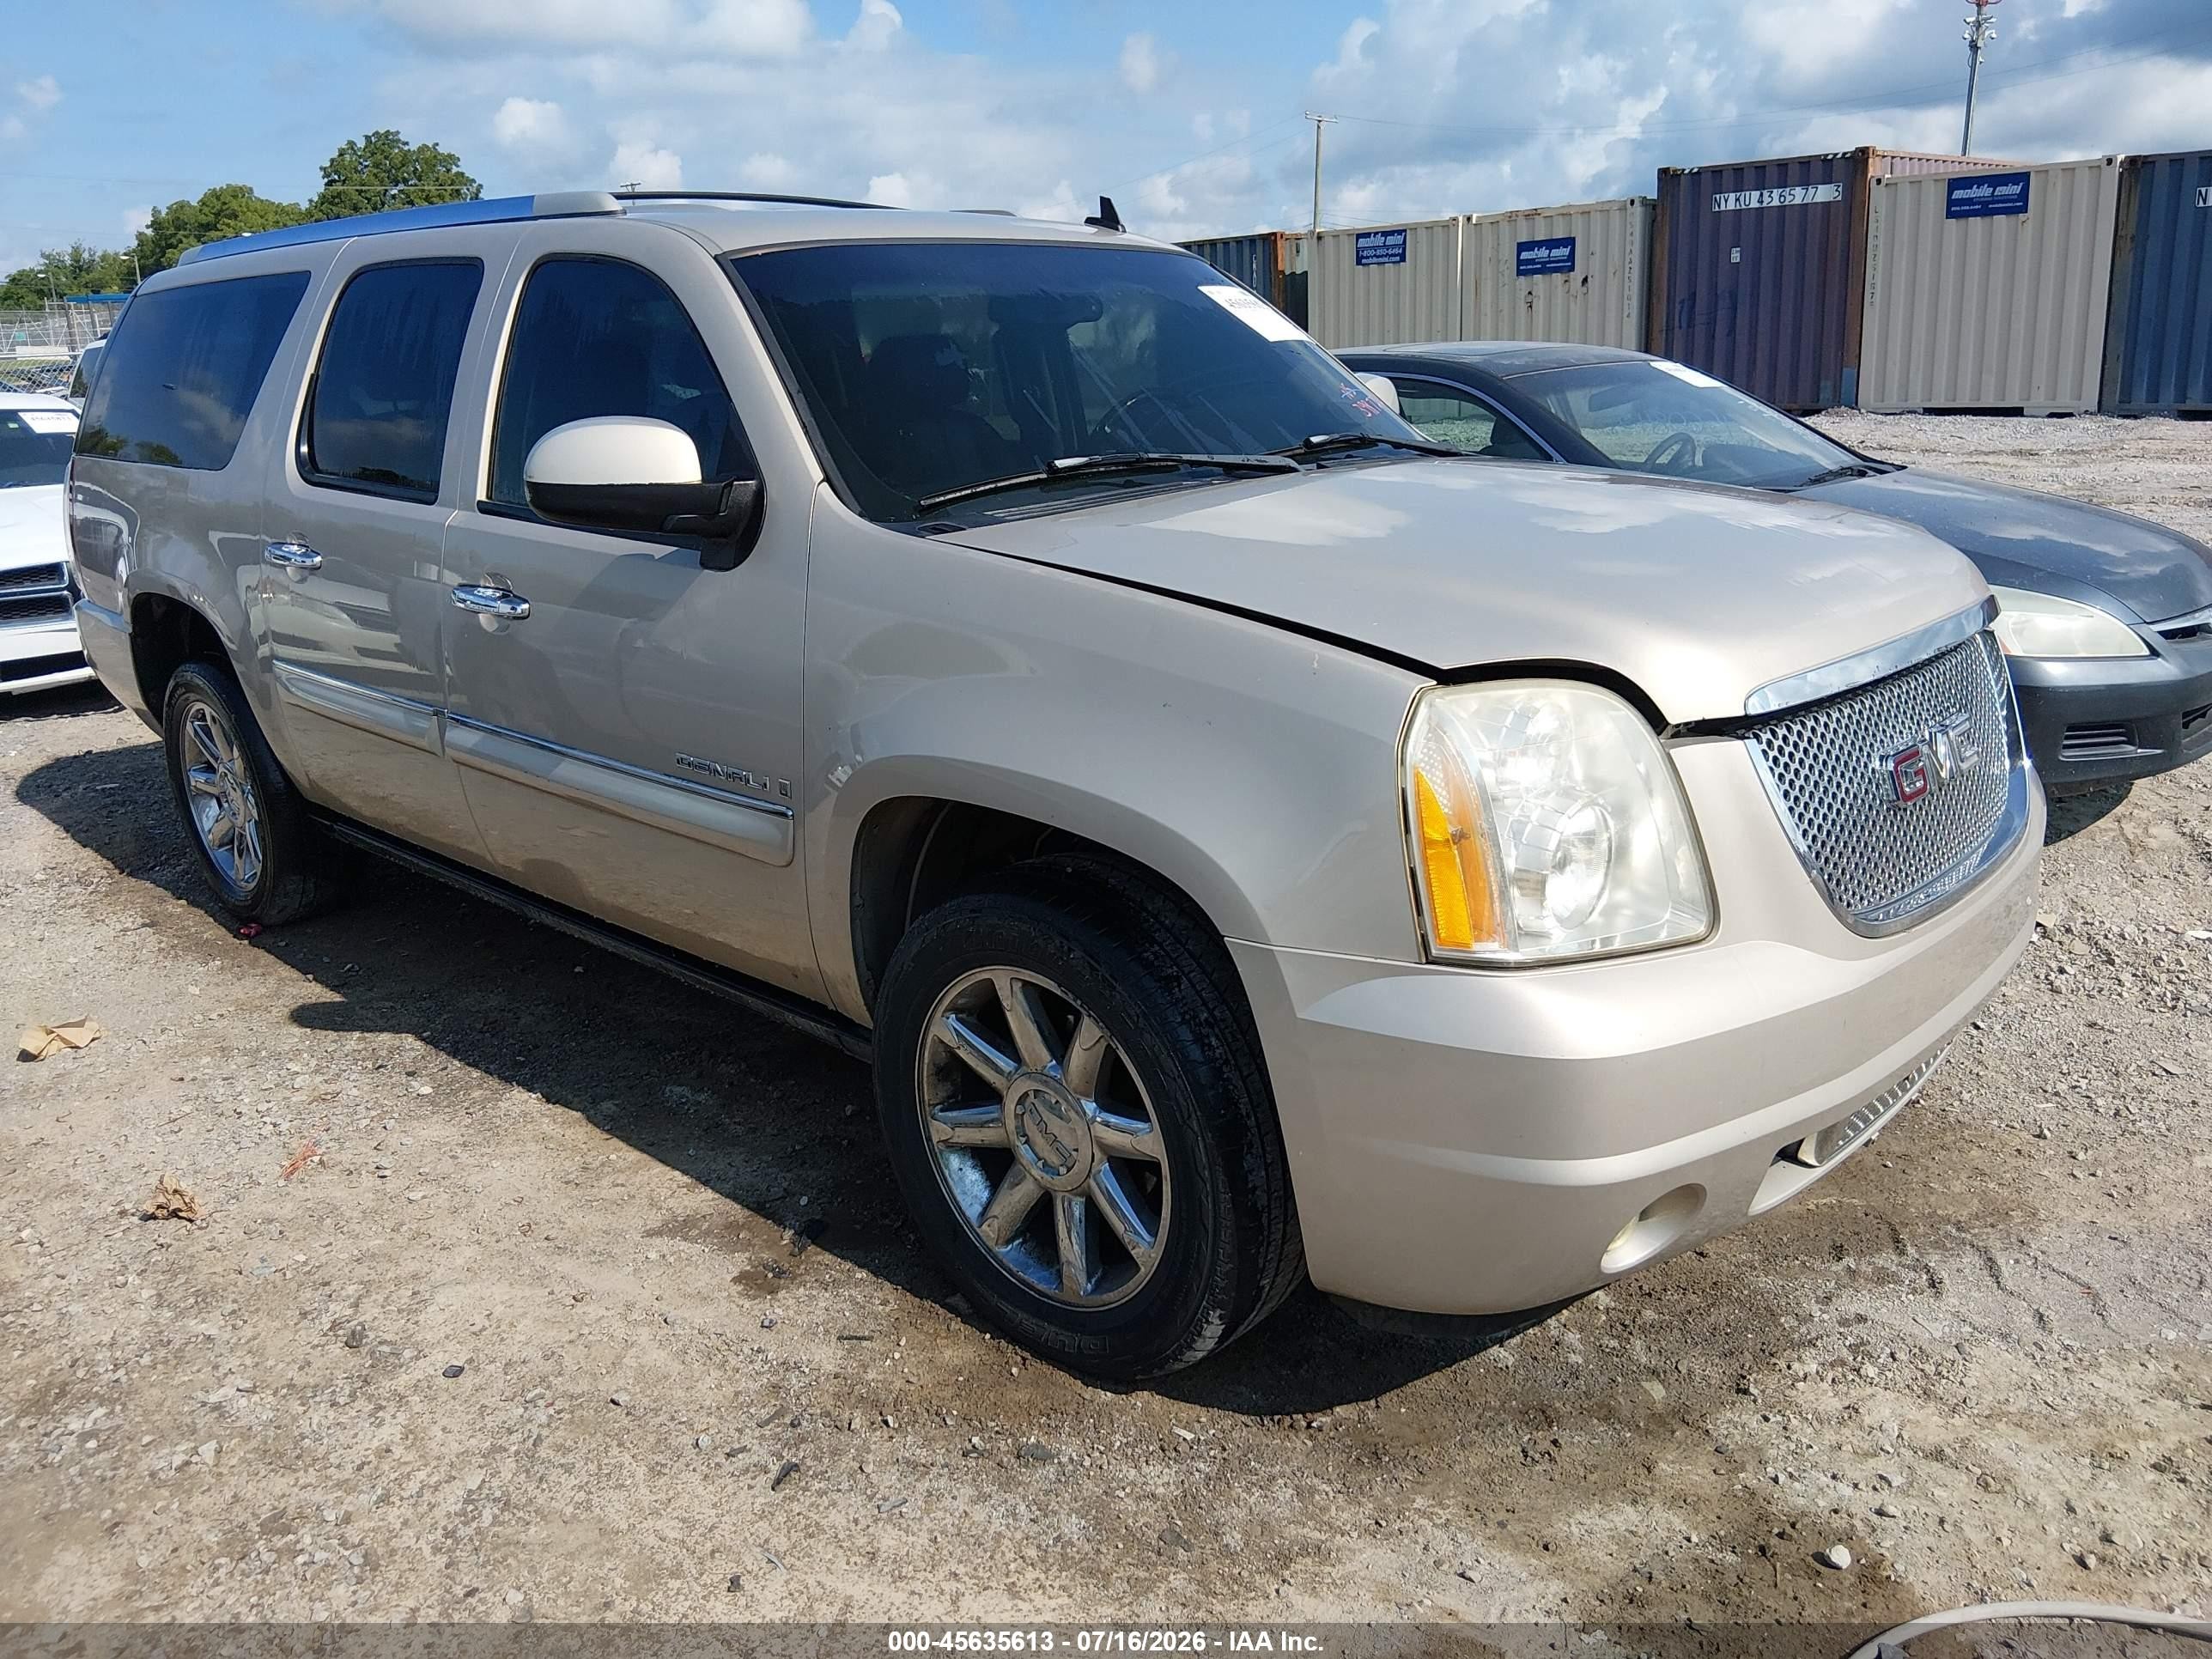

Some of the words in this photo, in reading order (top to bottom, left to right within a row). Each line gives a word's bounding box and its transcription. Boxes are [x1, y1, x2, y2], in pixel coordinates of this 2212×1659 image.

[1951, 184, 1994, 199] mobile
[1994, 183, 2024, 196] mini
[1358, 233, 1385, 247] mobile
[1385, 232, 1406, 246] mini
[1519, 246, 1550, 259] mobile
[1550, 245, 1572, 257] mini
[674, 752, 770, 791] DENALI
[1883, 714, 1980, 805] GMC
[1026, 1100, 1073, 1164] GMC
